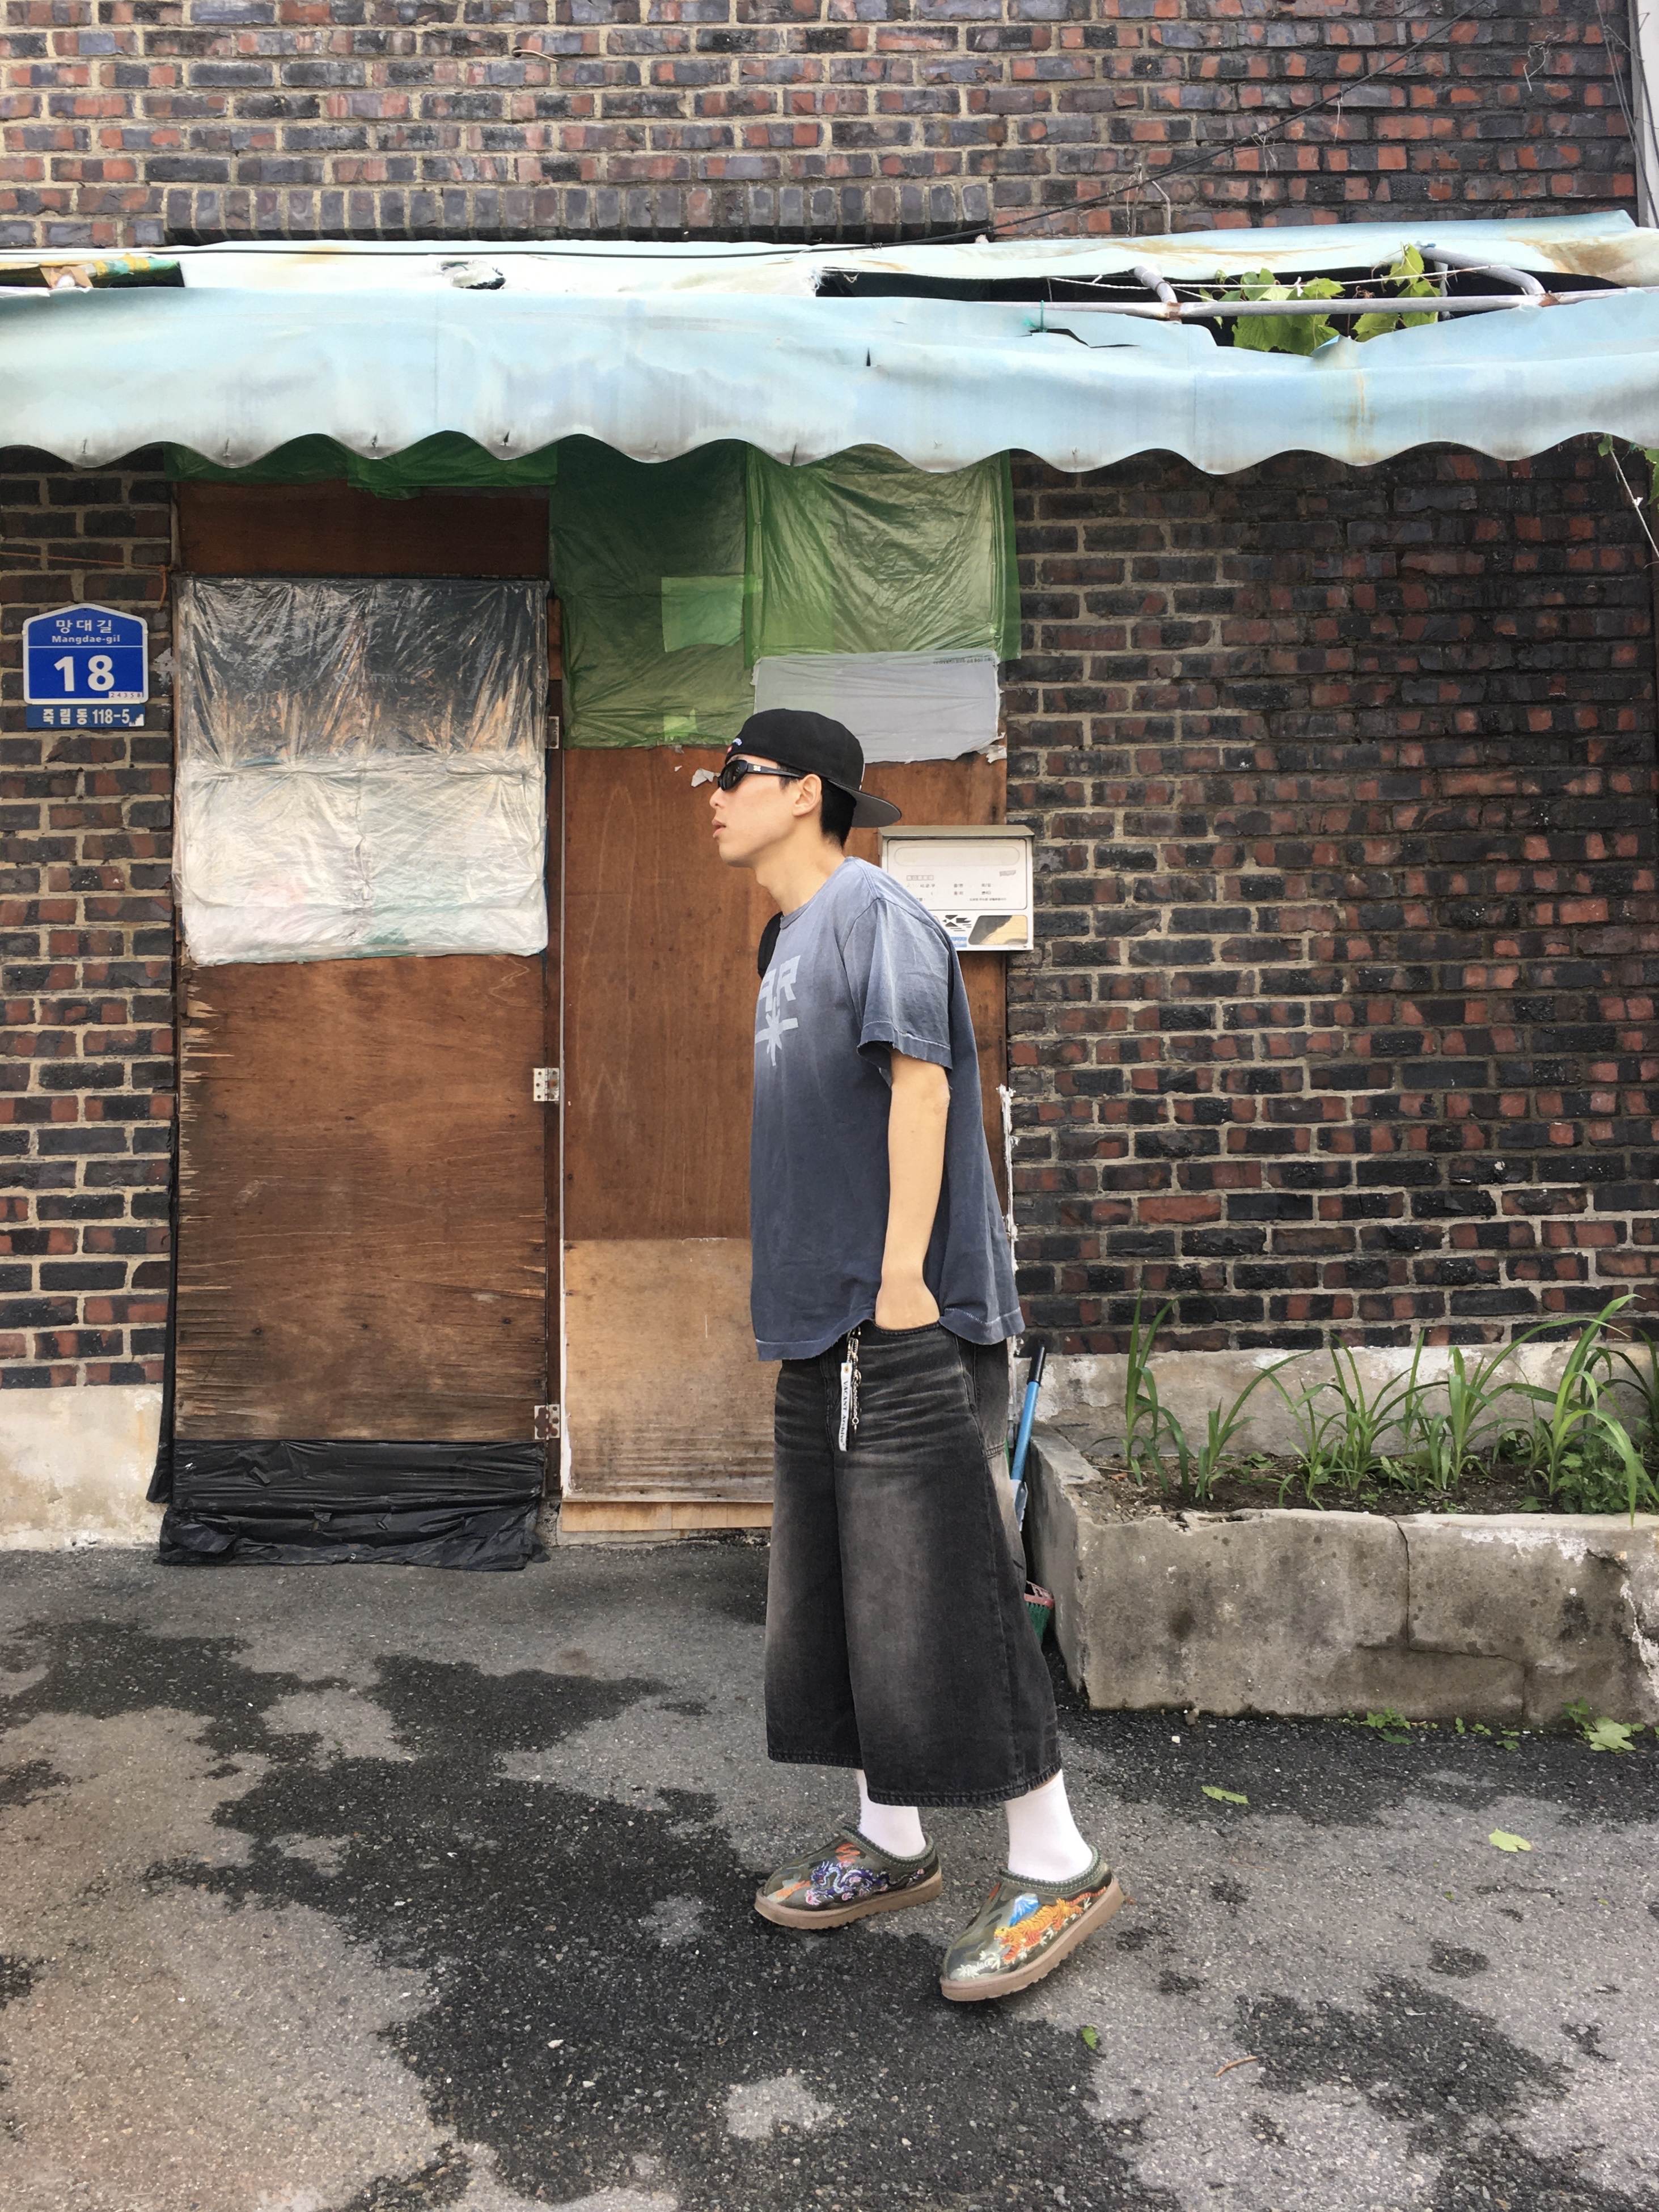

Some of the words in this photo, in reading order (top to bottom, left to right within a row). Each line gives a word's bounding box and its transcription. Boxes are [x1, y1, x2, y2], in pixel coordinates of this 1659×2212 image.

[56, 620, 112, 634] 망대길
[52, 634, 121, 644] Mangdae-gil
[54, 655, 115, 692] 18
[43, 708, 88, 725] 죽림동
[92, 708, 130, 724] 118-5
